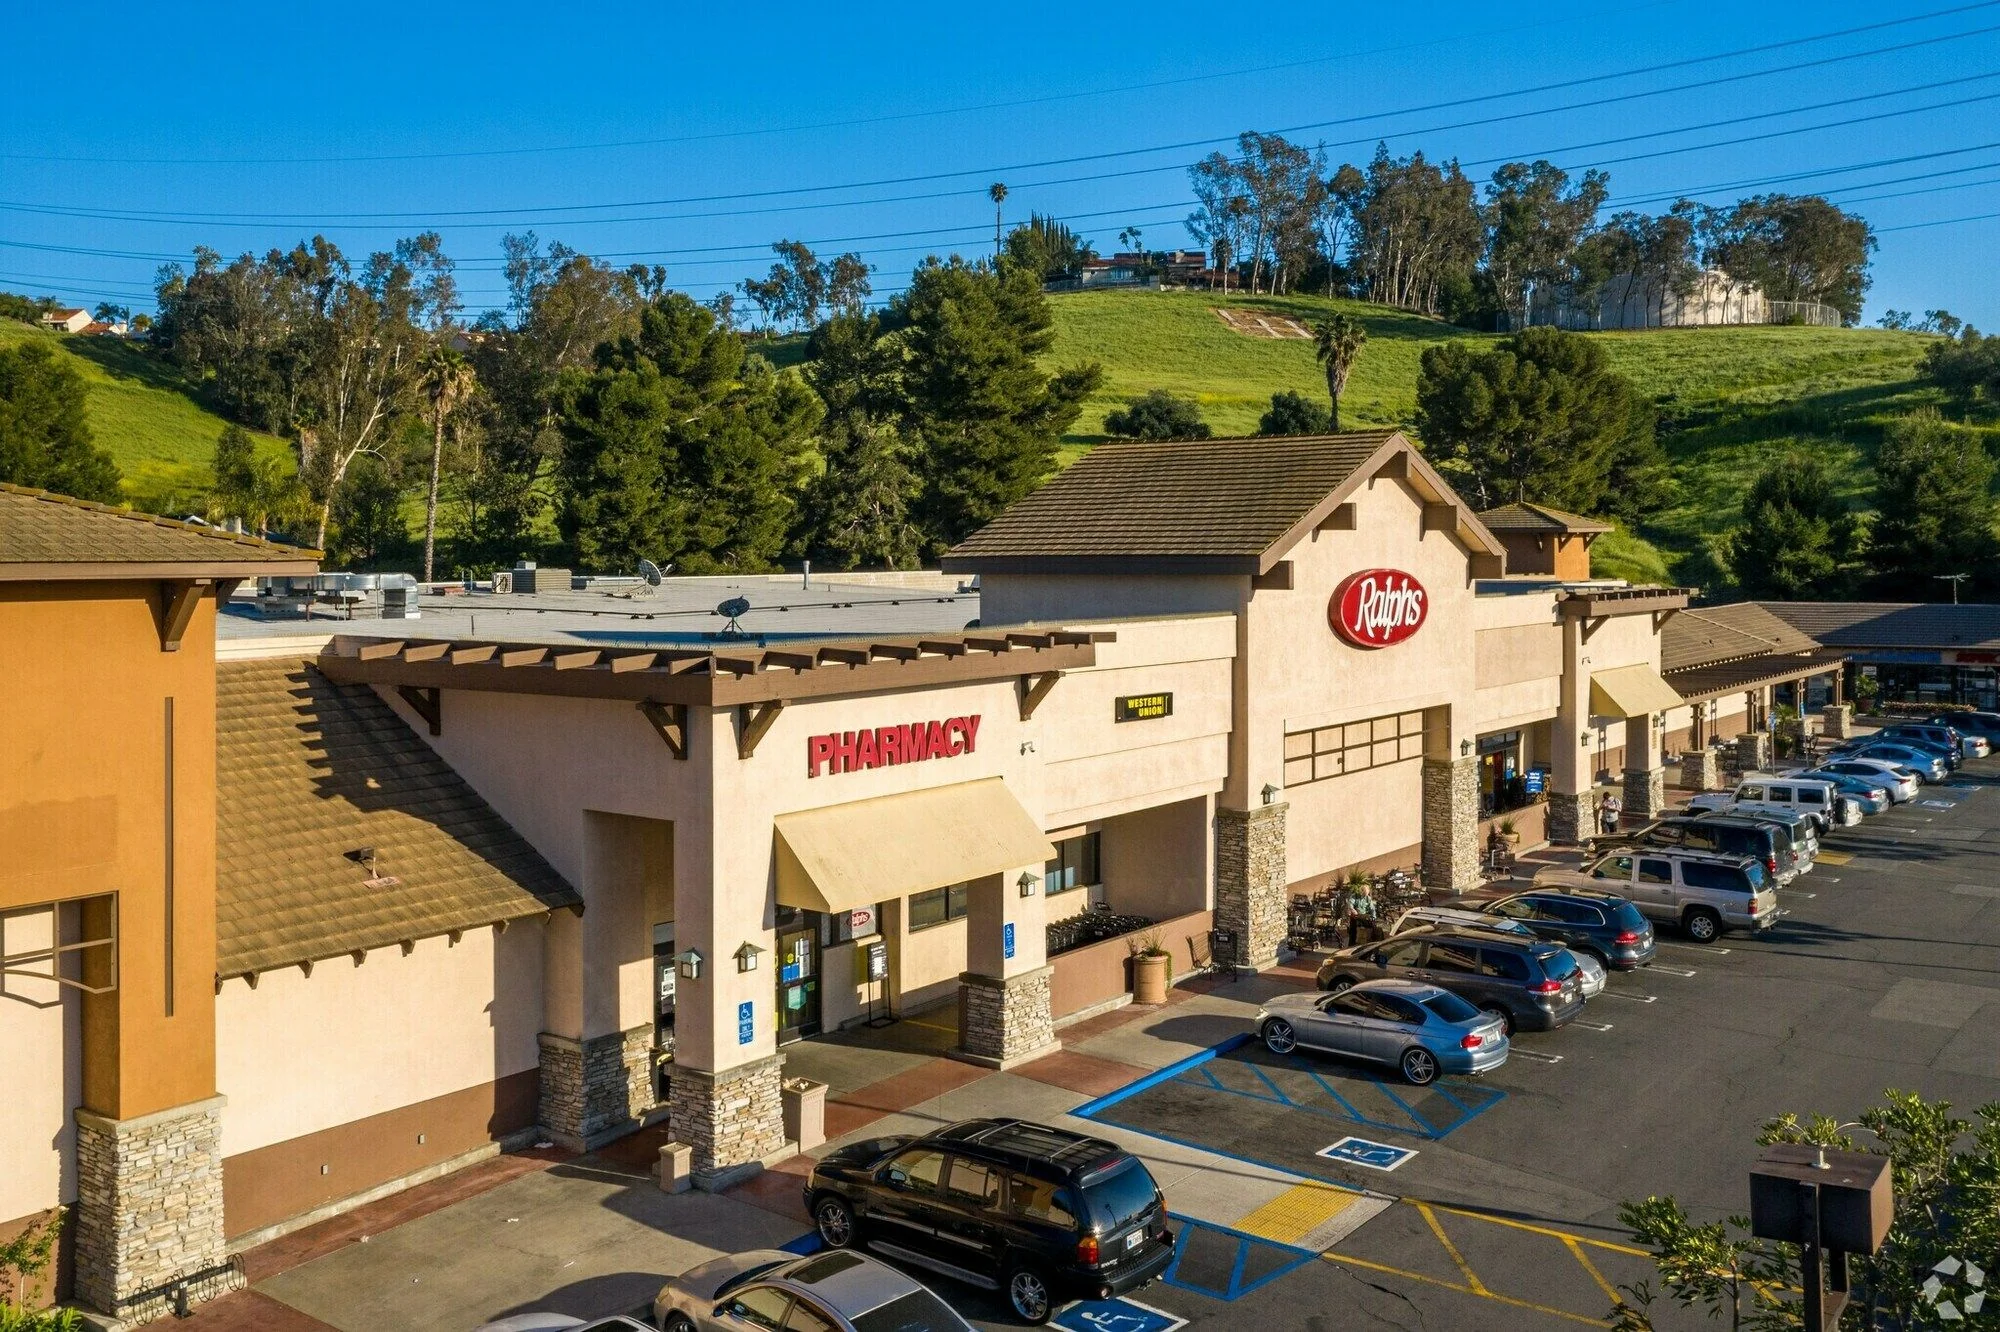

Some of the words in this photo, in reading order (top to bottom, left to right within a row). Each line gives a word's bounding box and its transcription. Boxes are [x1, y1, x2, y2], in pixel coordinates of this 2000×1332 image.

[1354, 575, 1423, 640] Ralphs
[1127, 696, 1164, 709] WESTERN
[1138, 706, 1164, 717] UNION
[808, 714, 981, 778] PHARMACY
